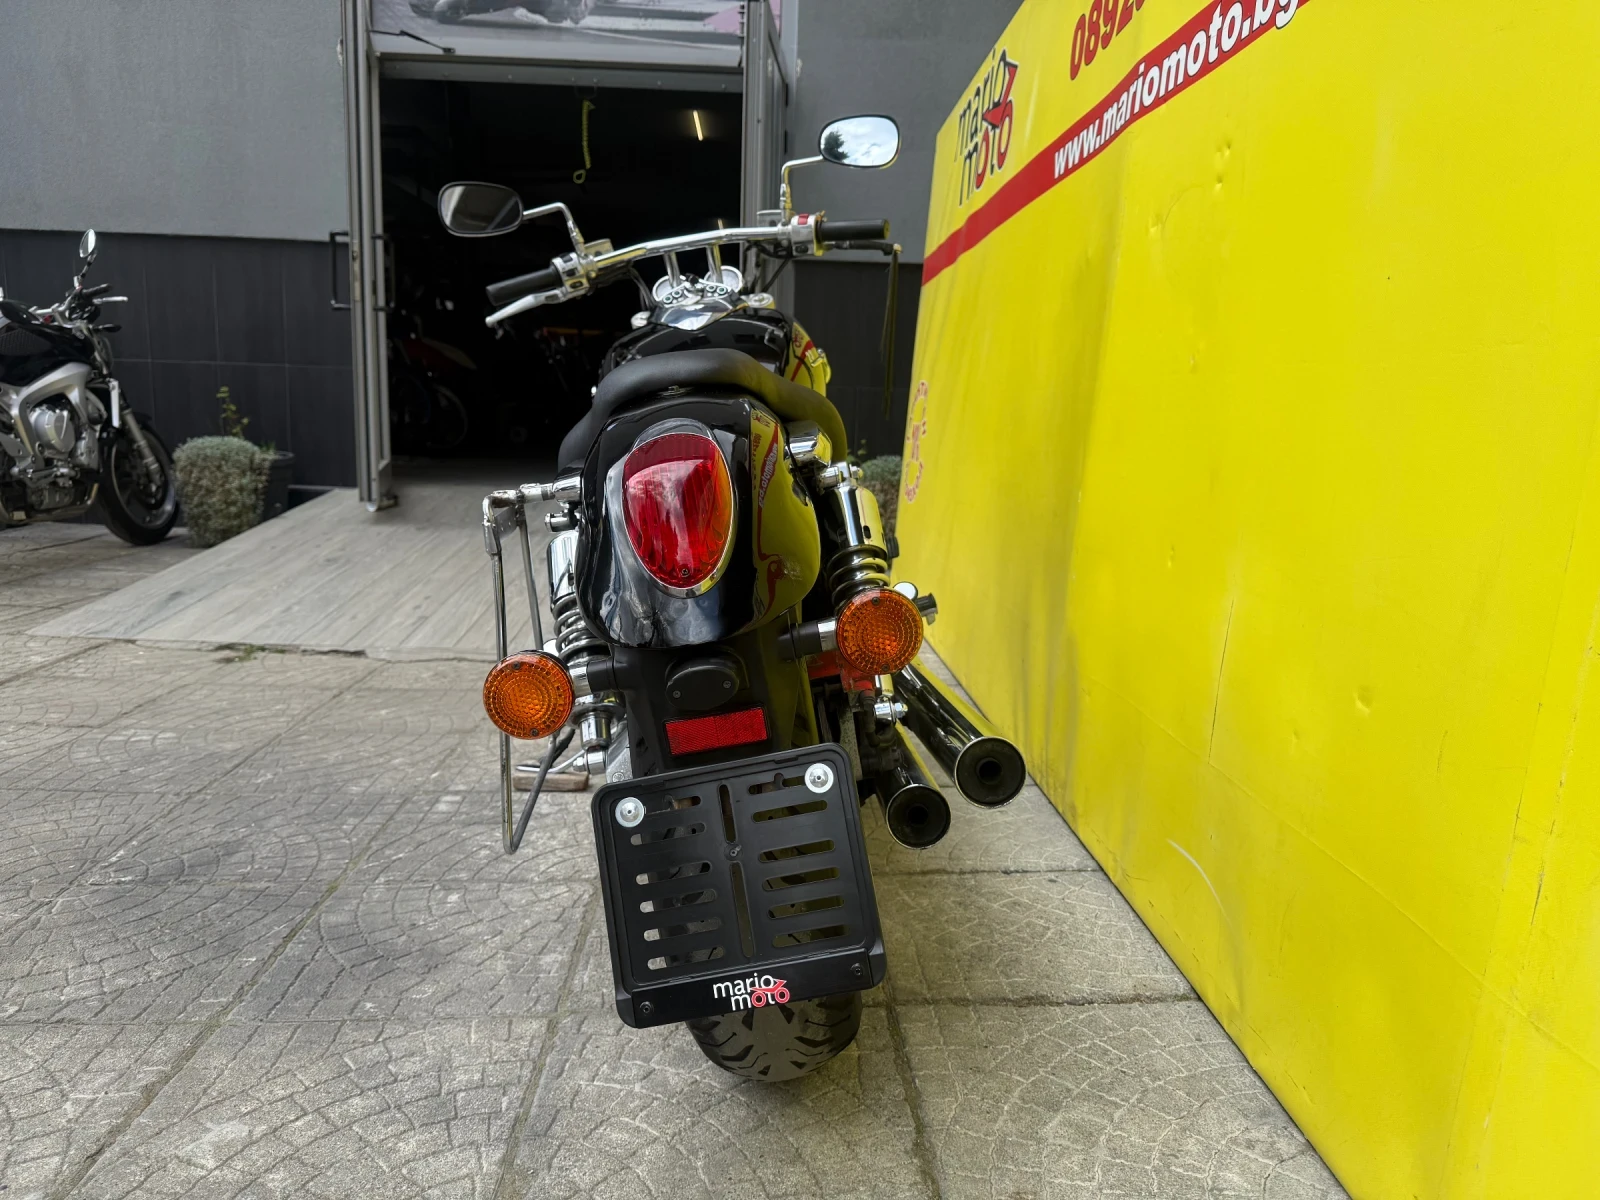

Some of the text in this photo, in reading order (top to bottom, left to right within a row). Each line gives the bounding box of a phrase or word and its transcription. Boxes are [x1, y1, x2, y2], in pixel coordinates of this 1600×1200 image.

[1070, 0, 1145, 81] 089
[954, 48, 1006, 163] mario
[959, 99, 1013, 206] moto
[713, 972, 775, 998] mario
[731, 986, 790, 1011] moto
